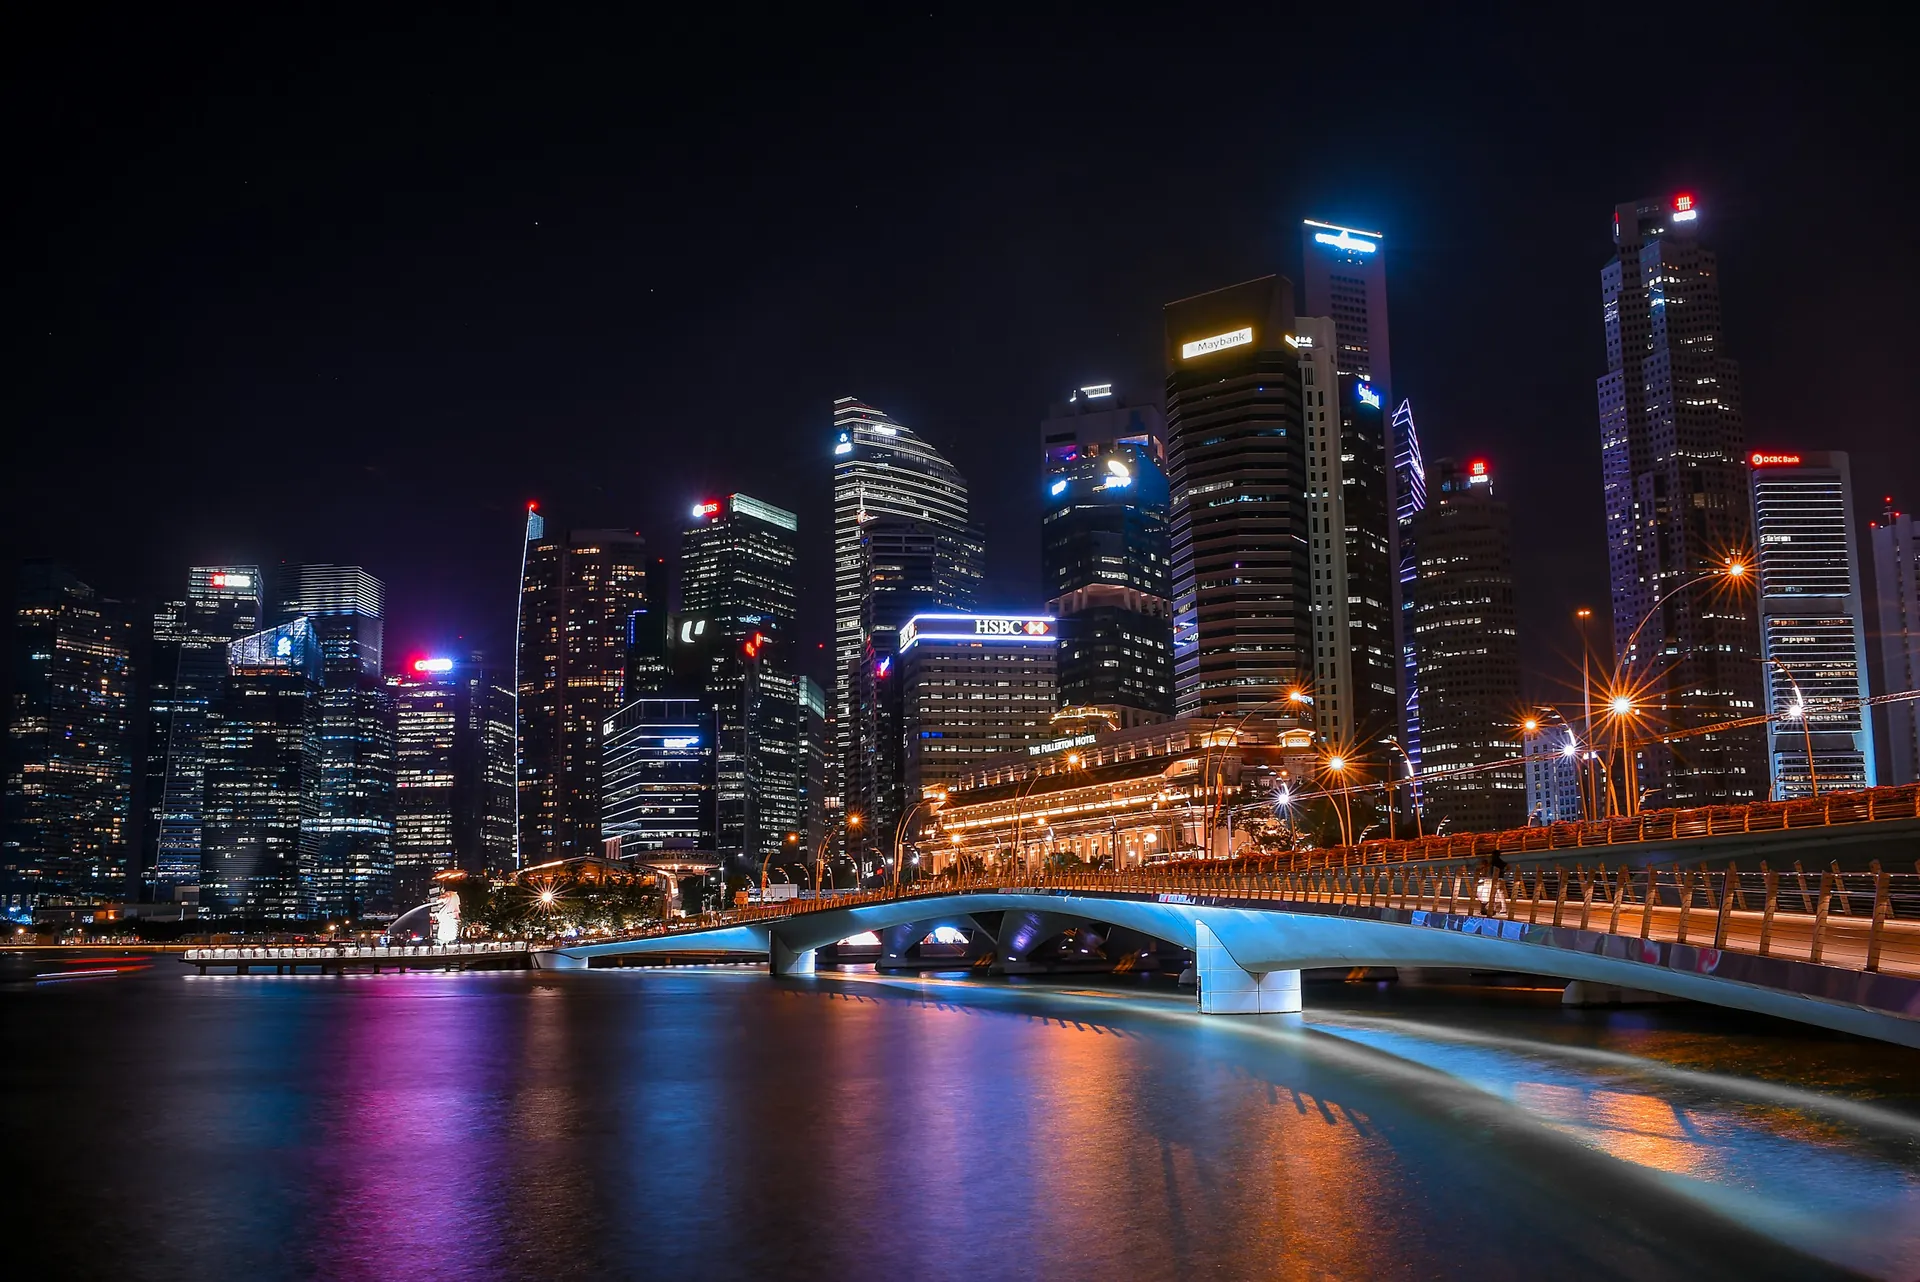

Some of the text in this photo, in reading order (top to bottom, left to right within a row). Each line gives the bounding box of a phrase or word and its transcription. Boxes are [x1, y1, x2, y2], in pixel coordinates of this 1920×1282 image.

[1197, 333, 1245, 351] Maybank
[975, 620, 1023, 634] HSBC
[603, 720, 614, 736] OUE
[1029, 735, 1096, 756] THE FULLERTON HOTEL
